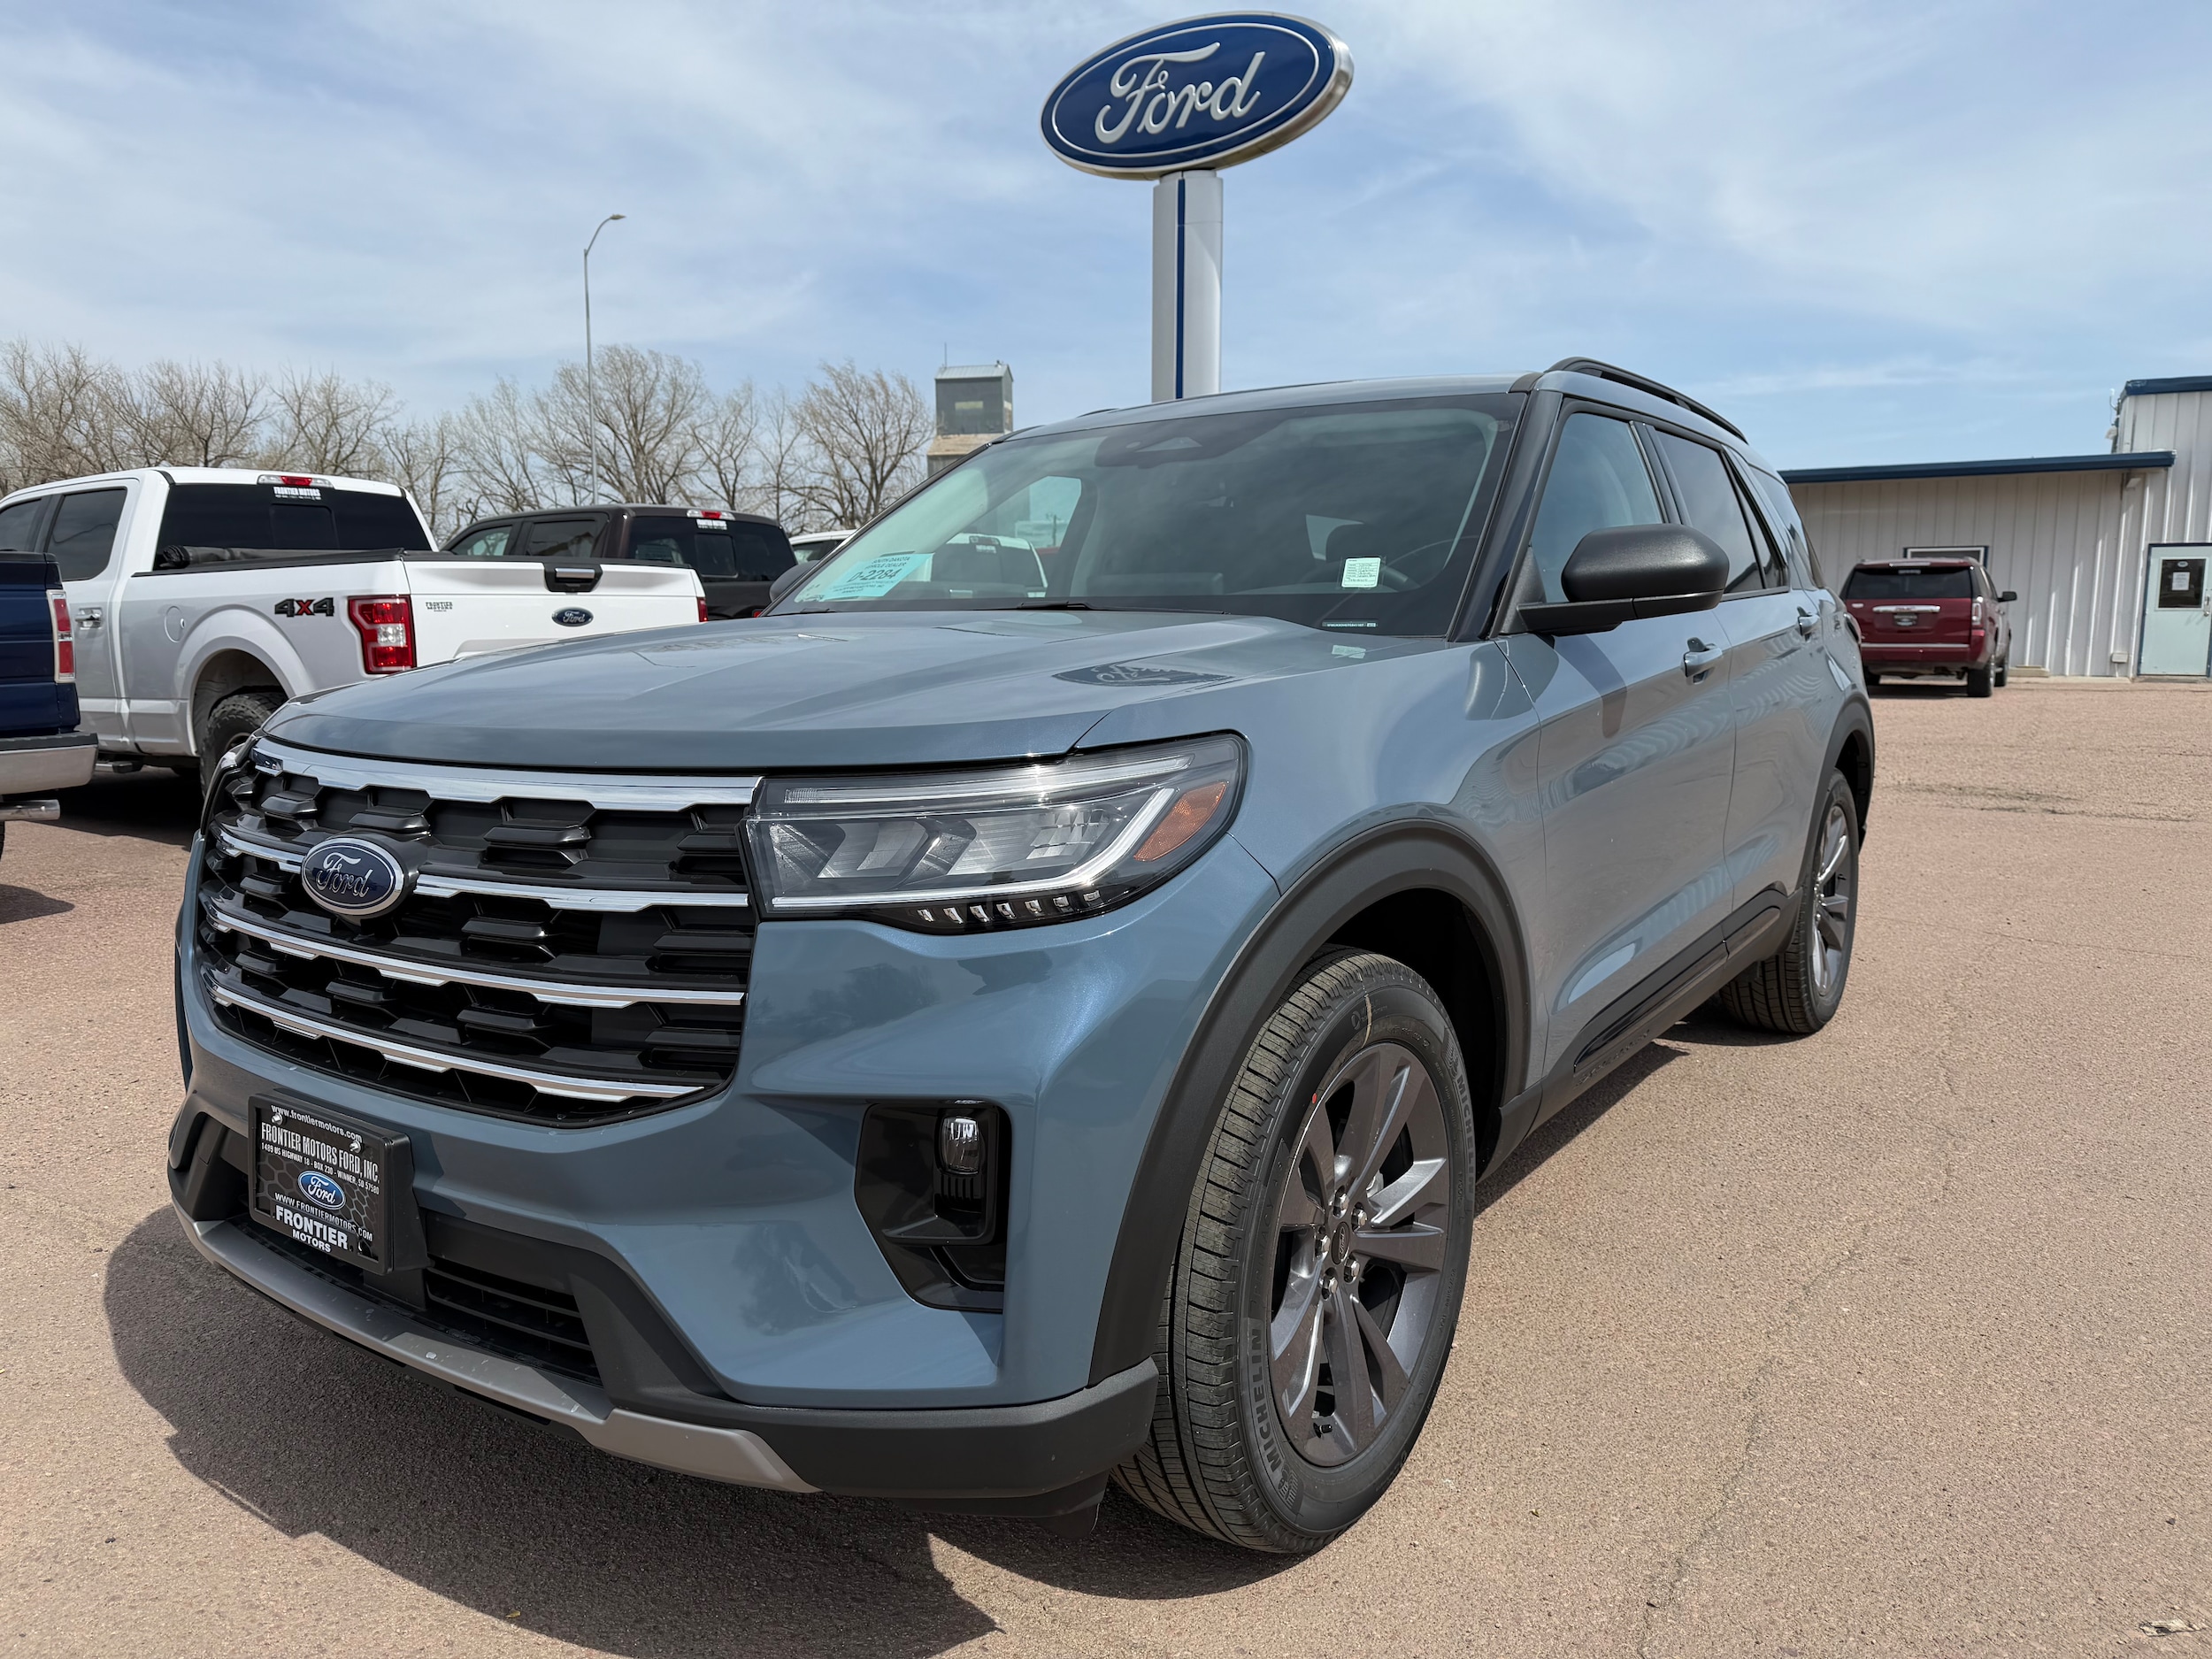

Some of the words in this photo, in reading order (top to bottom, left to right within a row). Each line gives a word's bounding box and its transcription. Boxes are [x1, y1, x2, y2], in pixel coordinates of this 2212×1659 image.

[1094, 42, 1265, 144] Ford
[847, 568, 902, 583] D-2284
[563, 610, 586, 623] Ford
[316, 852, 373, 898] Ford
[270, 1104, 363, 1143] www.frontiermotors.com
[1455, 1073, 1476, 1194] MICHELIN
[261, 1121, 302, 1152] FRONTIER
[302, 1135, 338, 1165] MOTORS
[339, 1149, 364, 1179] FORD,
[364, 1159, 380, 1184] INC.
[274, 1147, 281, 1156] US
[281, 1148, 303, 1164] HIGHWAY
[304, 1156, 311, 1166] 18
[314, 1160, 324, 1171] BOX
[324, 1165, 334, 1176] 230
[365, 1180, 380, 1194] 57580
[308, 1176, 336, 1204] Ford
[274, 1192, 373, 1242] WWW.FRONTIERMOTORS.COM
[275, 1204, 349, 1250] FRONTIER
[292, 1229, 332, 1254] MOTORS
[1251, 1327, 1283, 1474] MICHELIN
